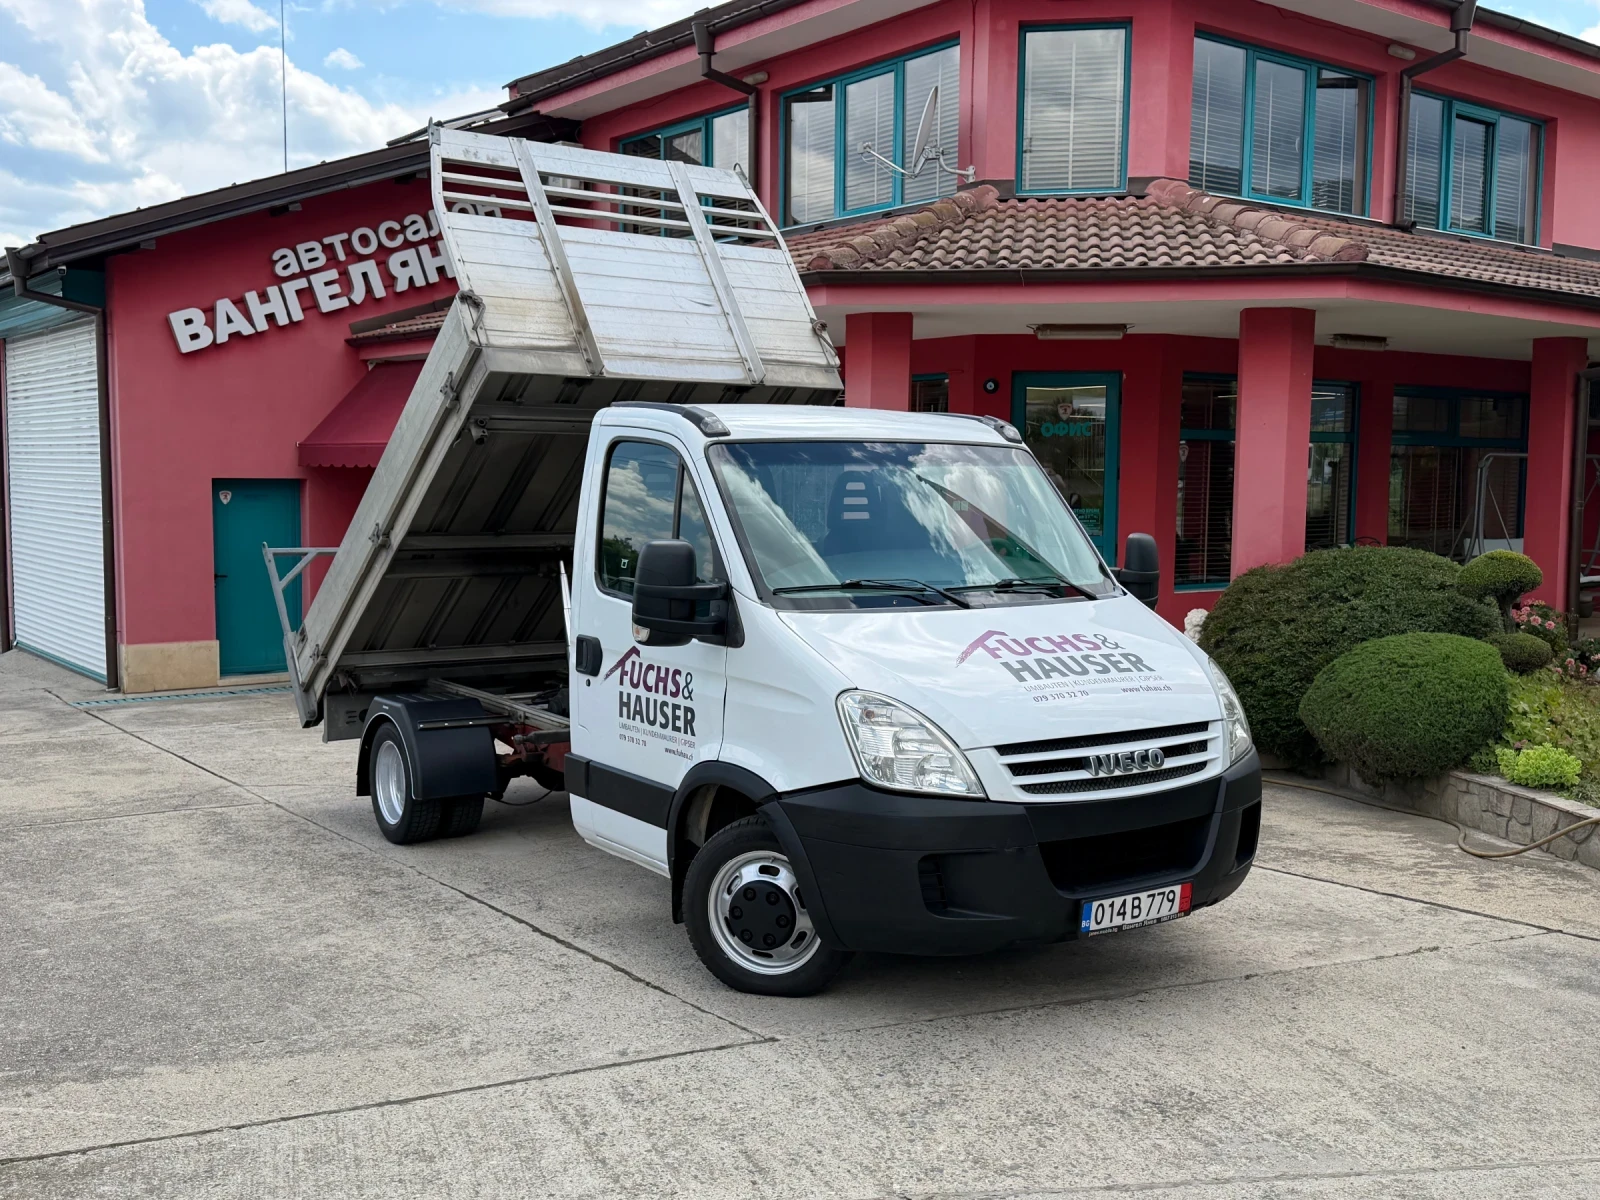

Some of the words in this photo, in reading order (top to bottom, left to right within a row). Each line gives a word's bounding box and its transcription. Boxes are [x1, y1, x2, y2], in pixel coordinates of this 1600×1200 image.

[167, 259, 387, 353] ВАНГЕЛ
[1041, 421, 1092, 437] ОФИС
[1000, 652, 1156, 682] HAUSER
[1023, 681, 1070, 693] UMBAUTEN
[1073, 676, 1134, 687] KUNDENMAURER
[1121, 684, 1173, 693] www.fuhau.ch
[1033, 694, 1049, 703] 079
[1050, 692, 1065, 701] 370
[1066, 691, 1077, 699] 32
[1078, 690, 1090, 698] 70
[619, 691, 696, 737] HAUSER
[1090, 748, 1165, 777] IVECO
[1082, 920, 1090, 928] BG
